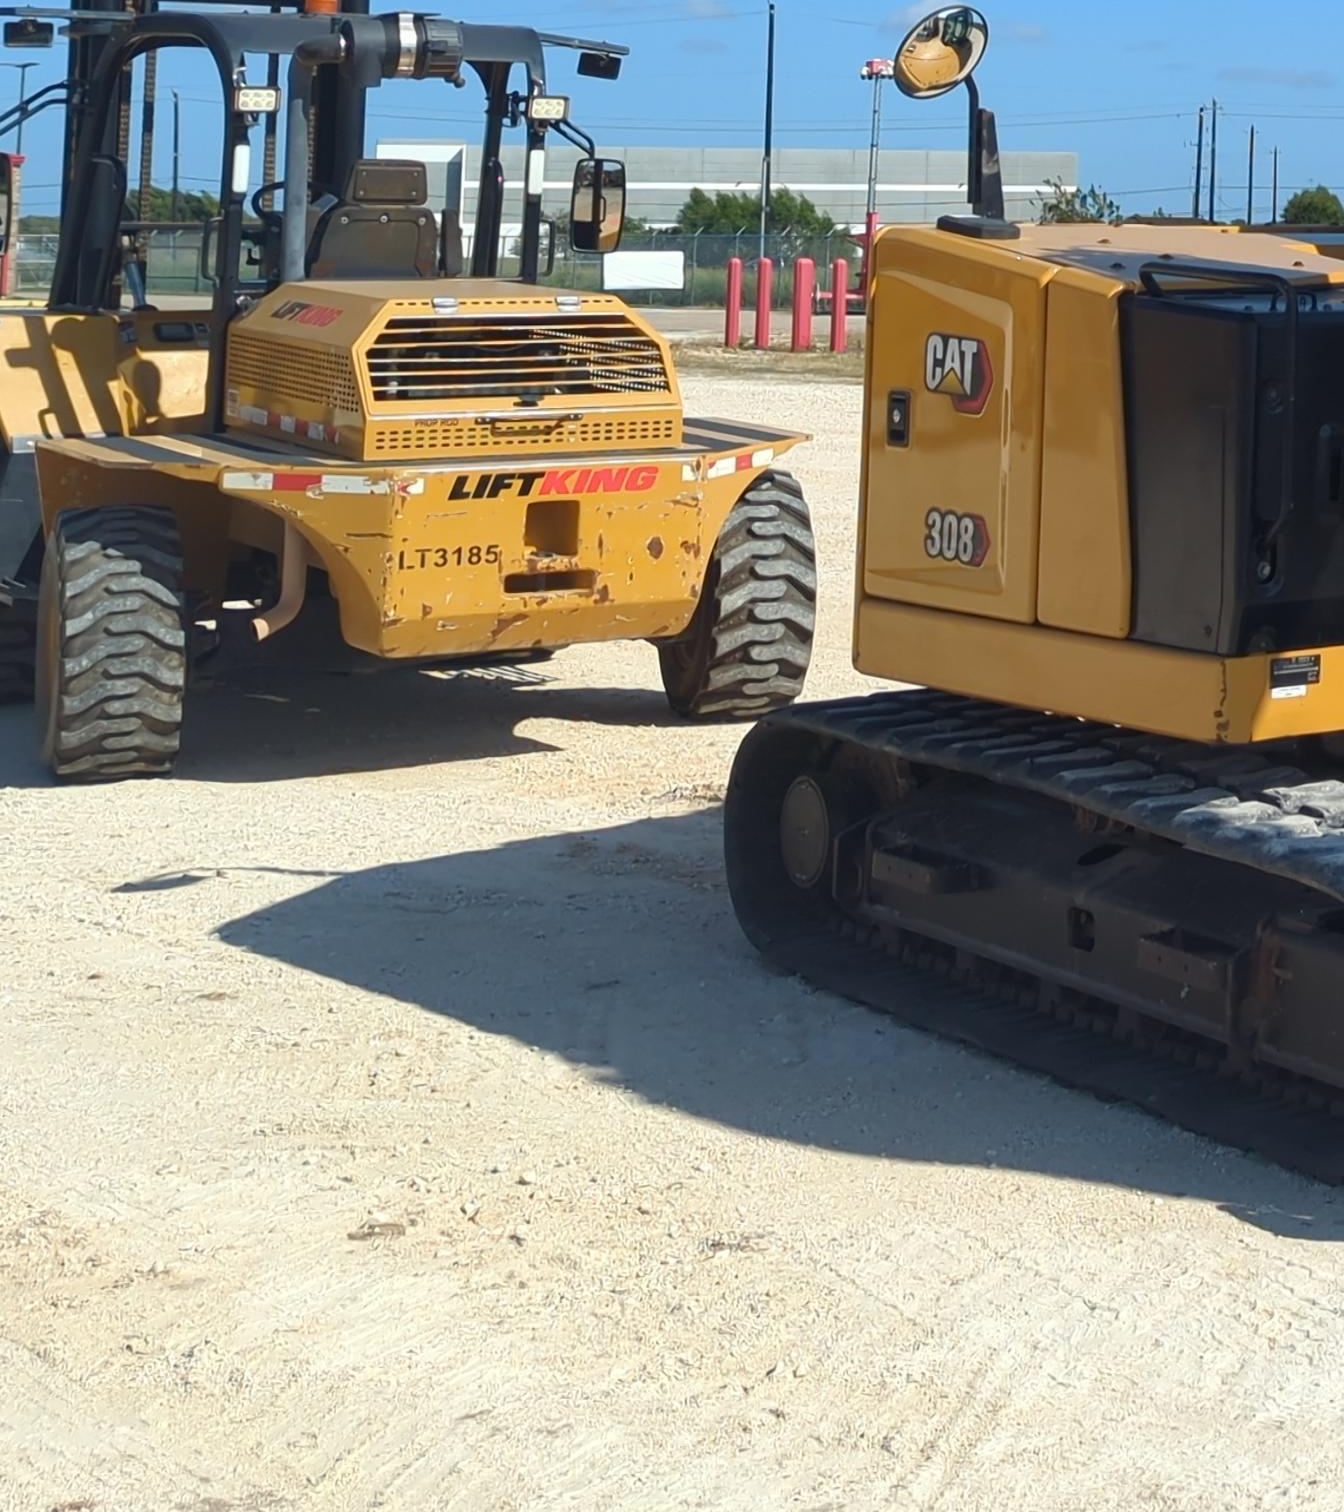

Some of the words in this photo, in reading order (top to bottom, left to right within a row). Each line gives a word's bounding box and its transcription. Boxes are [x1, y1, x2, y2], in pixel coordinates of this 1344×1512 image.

[926, 334, 977, 395] CAT
[399, 545, 499, 570] LT3185
[927, 510, 974, 563] 308
